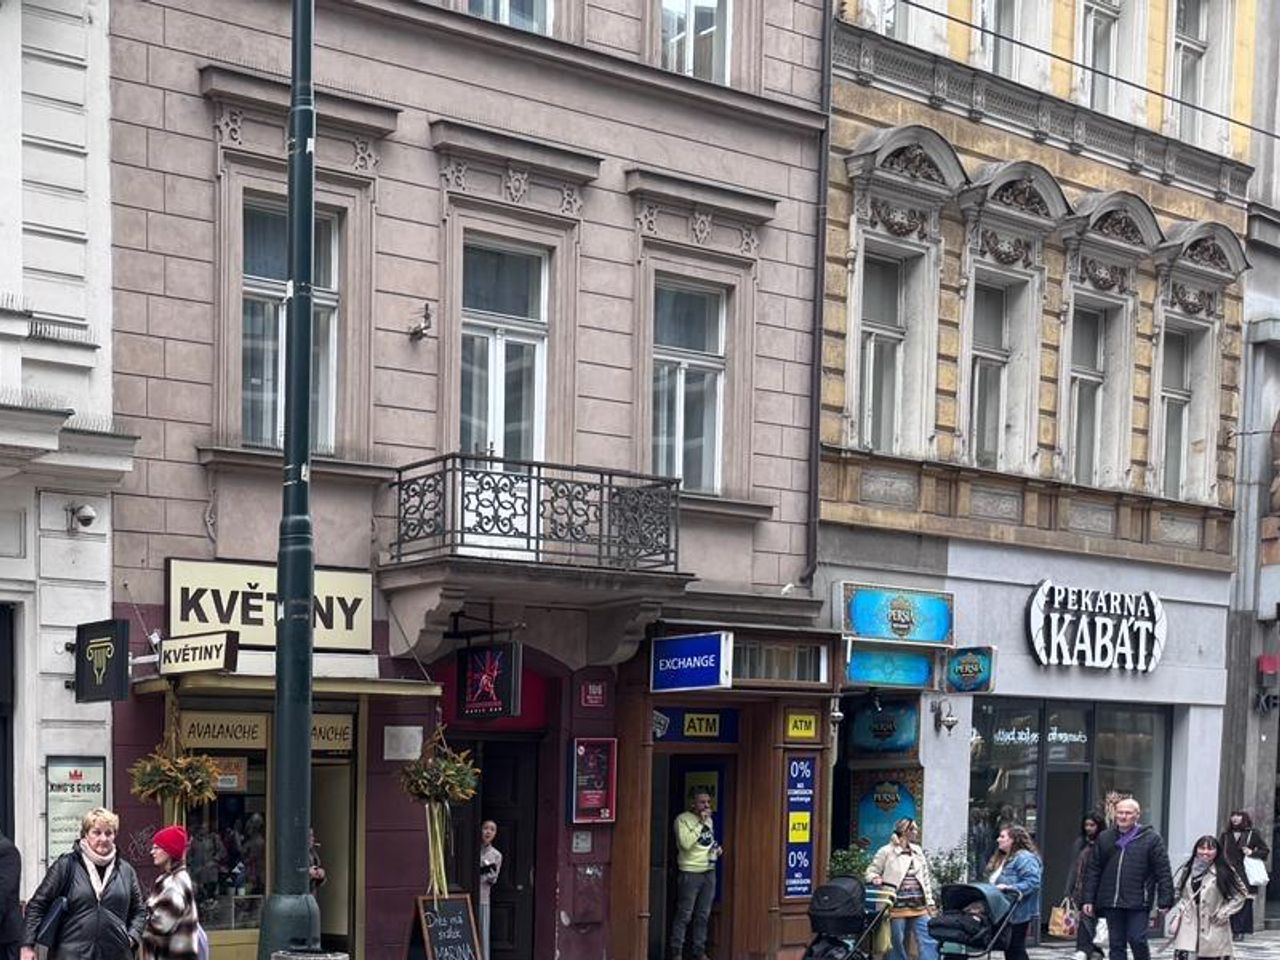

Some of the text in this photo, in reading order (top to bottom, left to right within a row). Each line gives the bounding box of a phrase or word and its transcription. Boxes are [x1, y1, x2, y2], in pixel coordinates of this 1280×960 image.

[180, 581, 363, 631] KVĚNY
[1049, 613, 1153, 671] KABÁT
[163, 643, 223, 665] KVĚTINY
[659, 654, 716, 671] EXCHANGE
[187, 721, 259, 740] AVALANCHE
[311, 726, 350, 741] ANCHE
[686, 717, 717, 733] ATM
[791, 719, 813, 732] ATM
[790, 761, 811, 778] 0%
[791, 822, 808, 831] ATM
[788, 851, 809, 868] 0%
